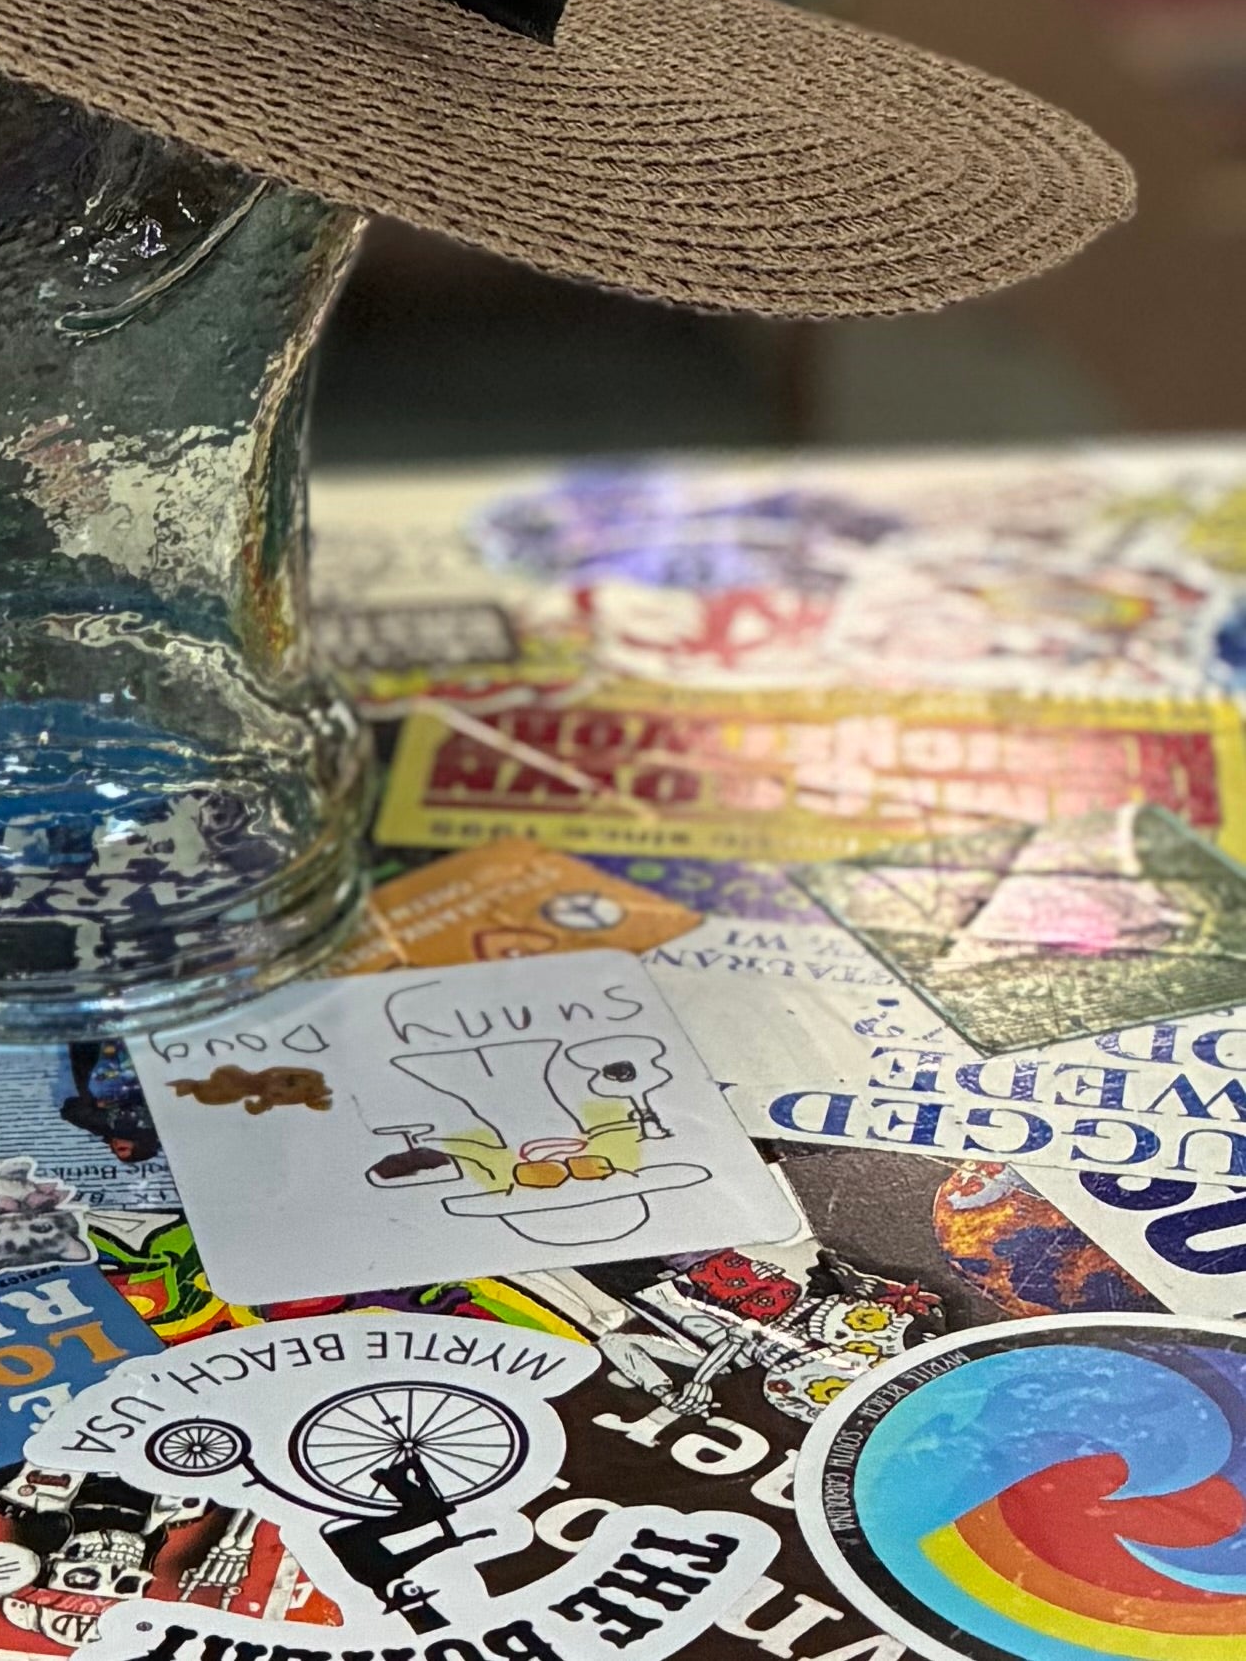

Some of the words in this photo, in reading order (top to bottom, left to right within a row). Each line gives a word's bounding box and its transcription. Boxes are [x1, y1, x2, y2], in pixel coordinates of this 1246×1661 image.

[383, 980, 645, 1045] Sunny
[150, 1023, 331, 1064] Doug
[151, 1332, 344, 1395] BEACH,
[367, 1332, 565, 1380] MYRTLE
[904, 1350, 970, 1383] MYRTLE
[63, 1397, 165, 1454] USA
[857, 1382, 901, 1417] BEACH
[830, 1429, 865, 1467] SOUTH
[820, 1469, 852, 1532] CAROLINA
[548, 1527, 740, 1650] THE
